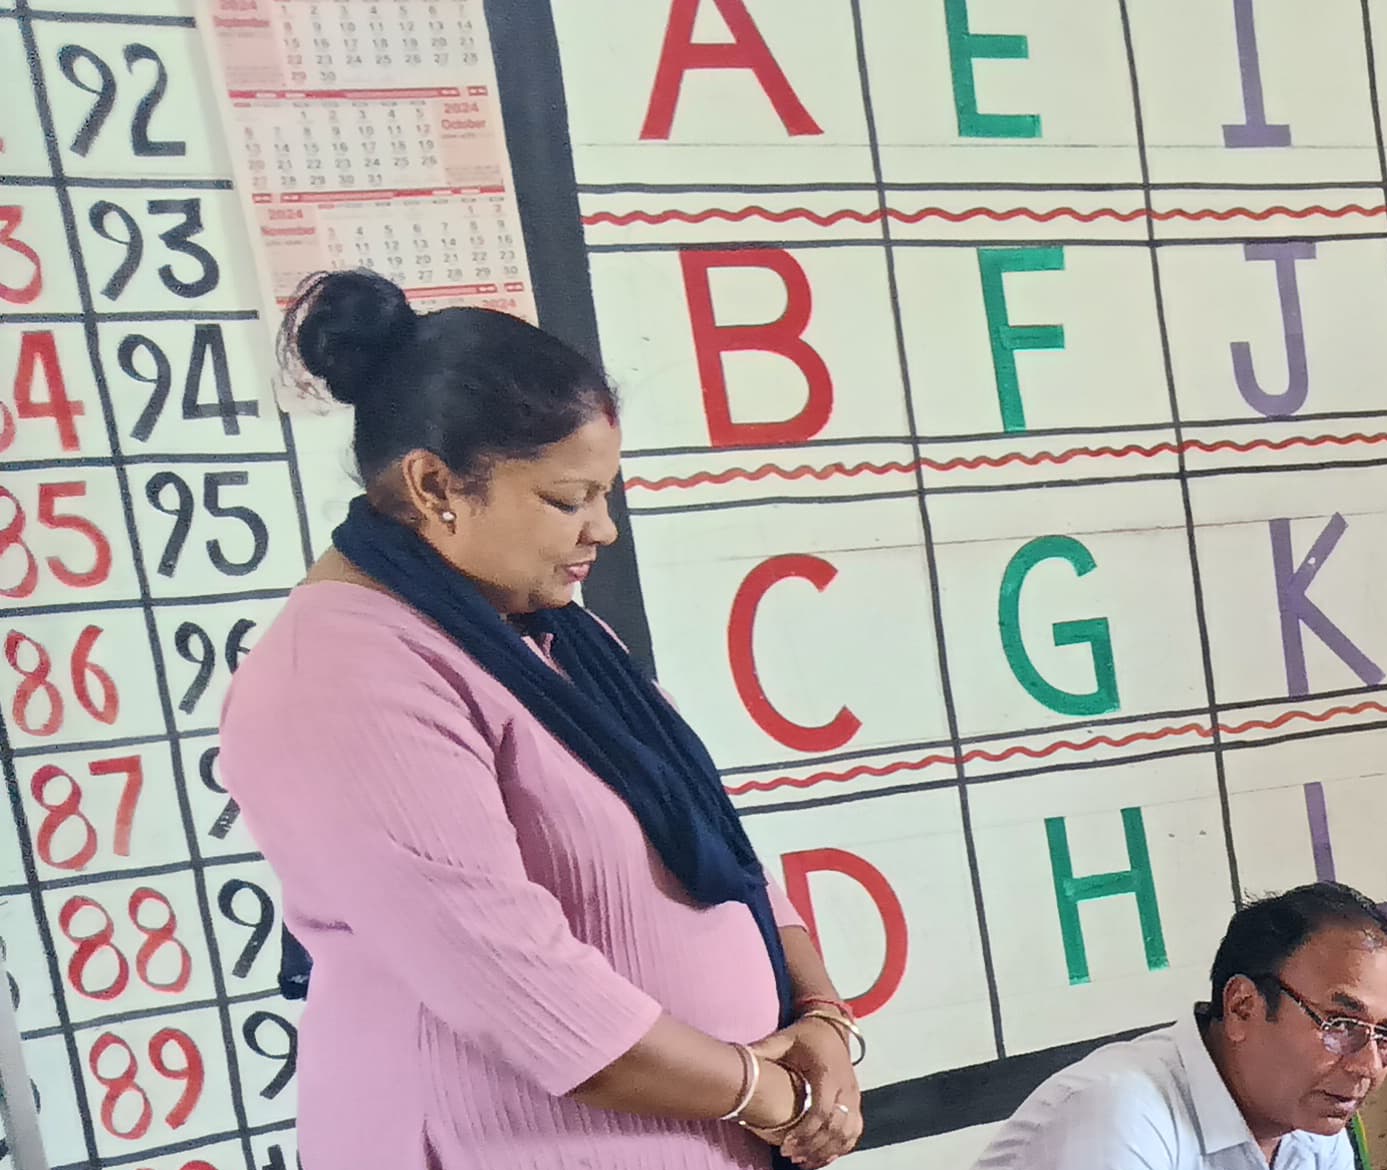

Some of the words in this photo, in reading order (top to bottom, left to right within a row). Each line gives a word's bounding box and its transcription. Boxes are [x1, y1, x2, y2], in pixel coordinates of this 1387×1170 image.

[56, 42, 187, 158] 92
[639, 0, 825, 140] A
[0, 204, 42, 305] 3
[89, 199, 220, 301] 93
[0, 330, 85, 452] 4
[117, 324, 260, 443] 94
[679, 248, 834, 448] B
[977, 247, 1064, 433] F
[1231, 242, 1316, 418] J
[0, 480, 113, 598] 85
[144, 471, 270, 579] 95
[4, 624, 120, 740] 86
[727, 553, 862, 753] C
[998, 535, 1121, 716] G
[1269, 511, 1386, 697] K
[30, 755, 144, 872] 87
[58, 886, 192, 1001] 88
[780, 847, 908, 1019] D
[1044, 807, 1170, 986] H
[89, 1027, 205, 1141] 89
